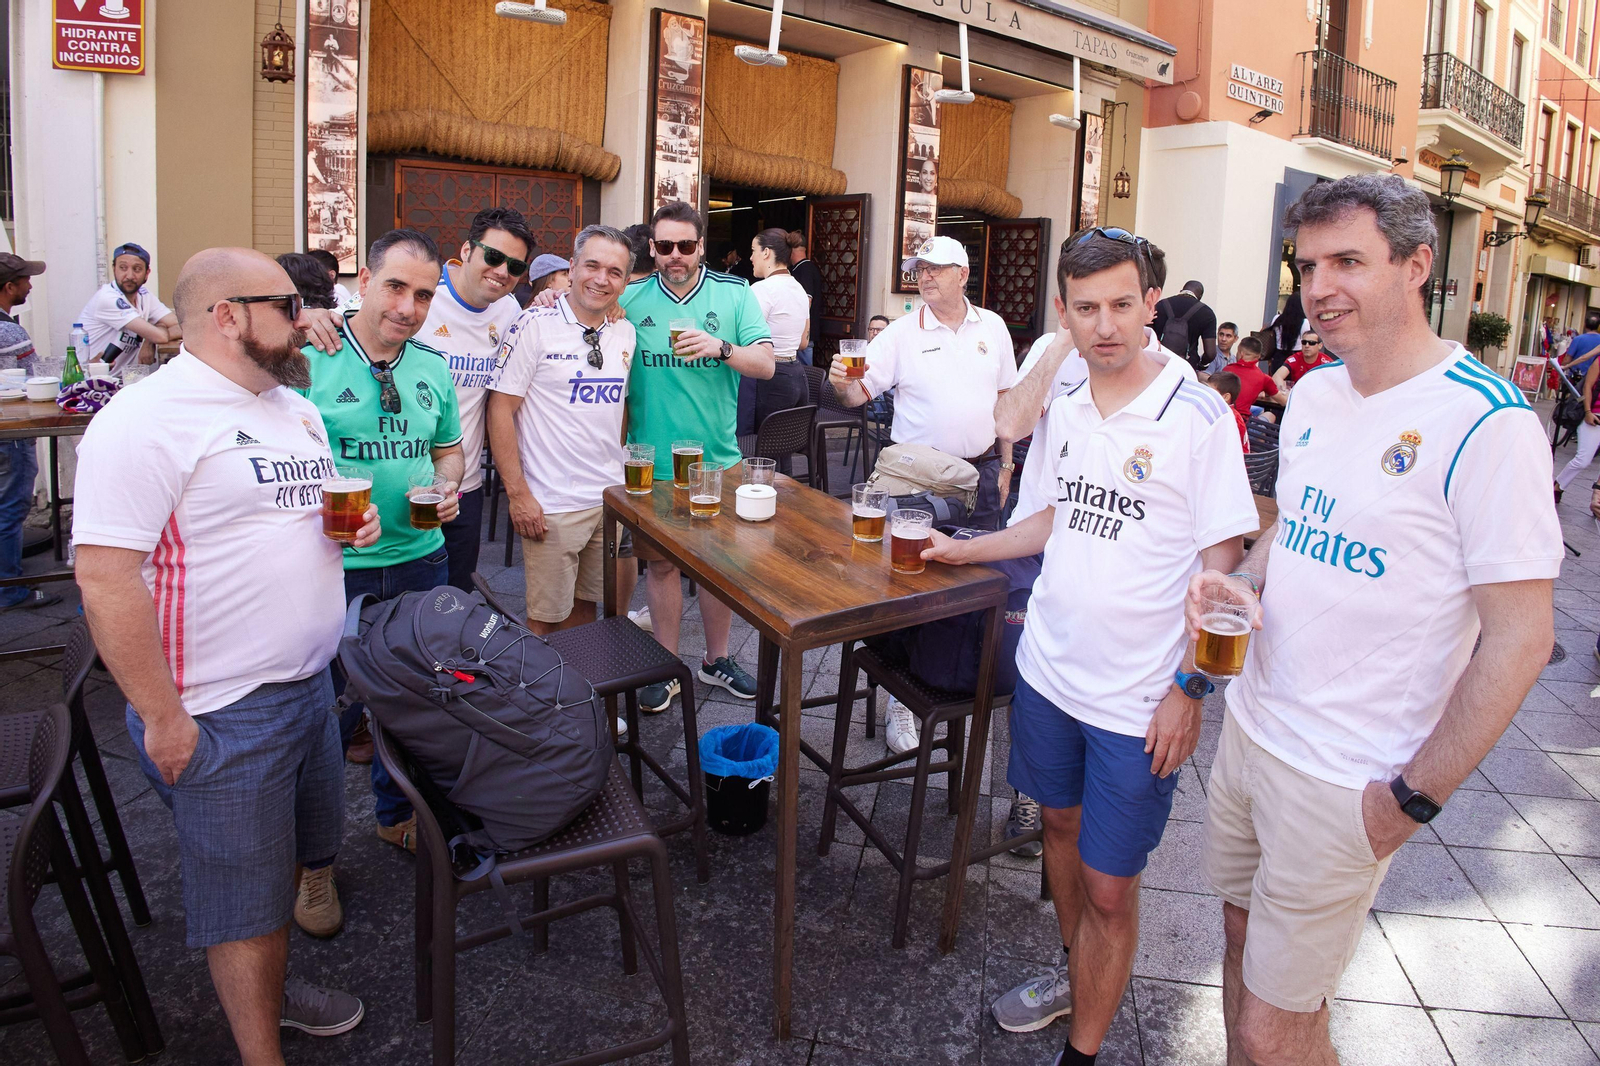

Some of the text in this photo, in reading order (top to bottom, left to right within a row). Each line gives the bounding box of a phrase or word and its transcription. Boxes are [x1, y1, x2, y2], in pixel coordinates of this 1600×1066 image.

[61, 27, 137, 42] HIDRANTE
[1073, 30, 1118, 59] TAPAS
[67, 39, 132, 54] CONTRA
[59, 51, 140, 67] INCENDIOS
[658, 78, 702, 95] Cruzcampo
[1232, 65, 1284, 94] ALVAREZ
[1229, 83, 1284, 112] QUINTERO
[902, 271, 918, 282] GU
[546, 353, 579, 361] KELME
[378, 416, 408, 436] Fly
[339, 434, 430, 461] Emirate
[248, 455, 336, 484] Emirate
[299, 484, 323, 507] BETT
[1300, 485, 1336, 524] Fly
[1068, 508, 1124, 541] BETTER
[434, 592, 451, 612] OSPREY
